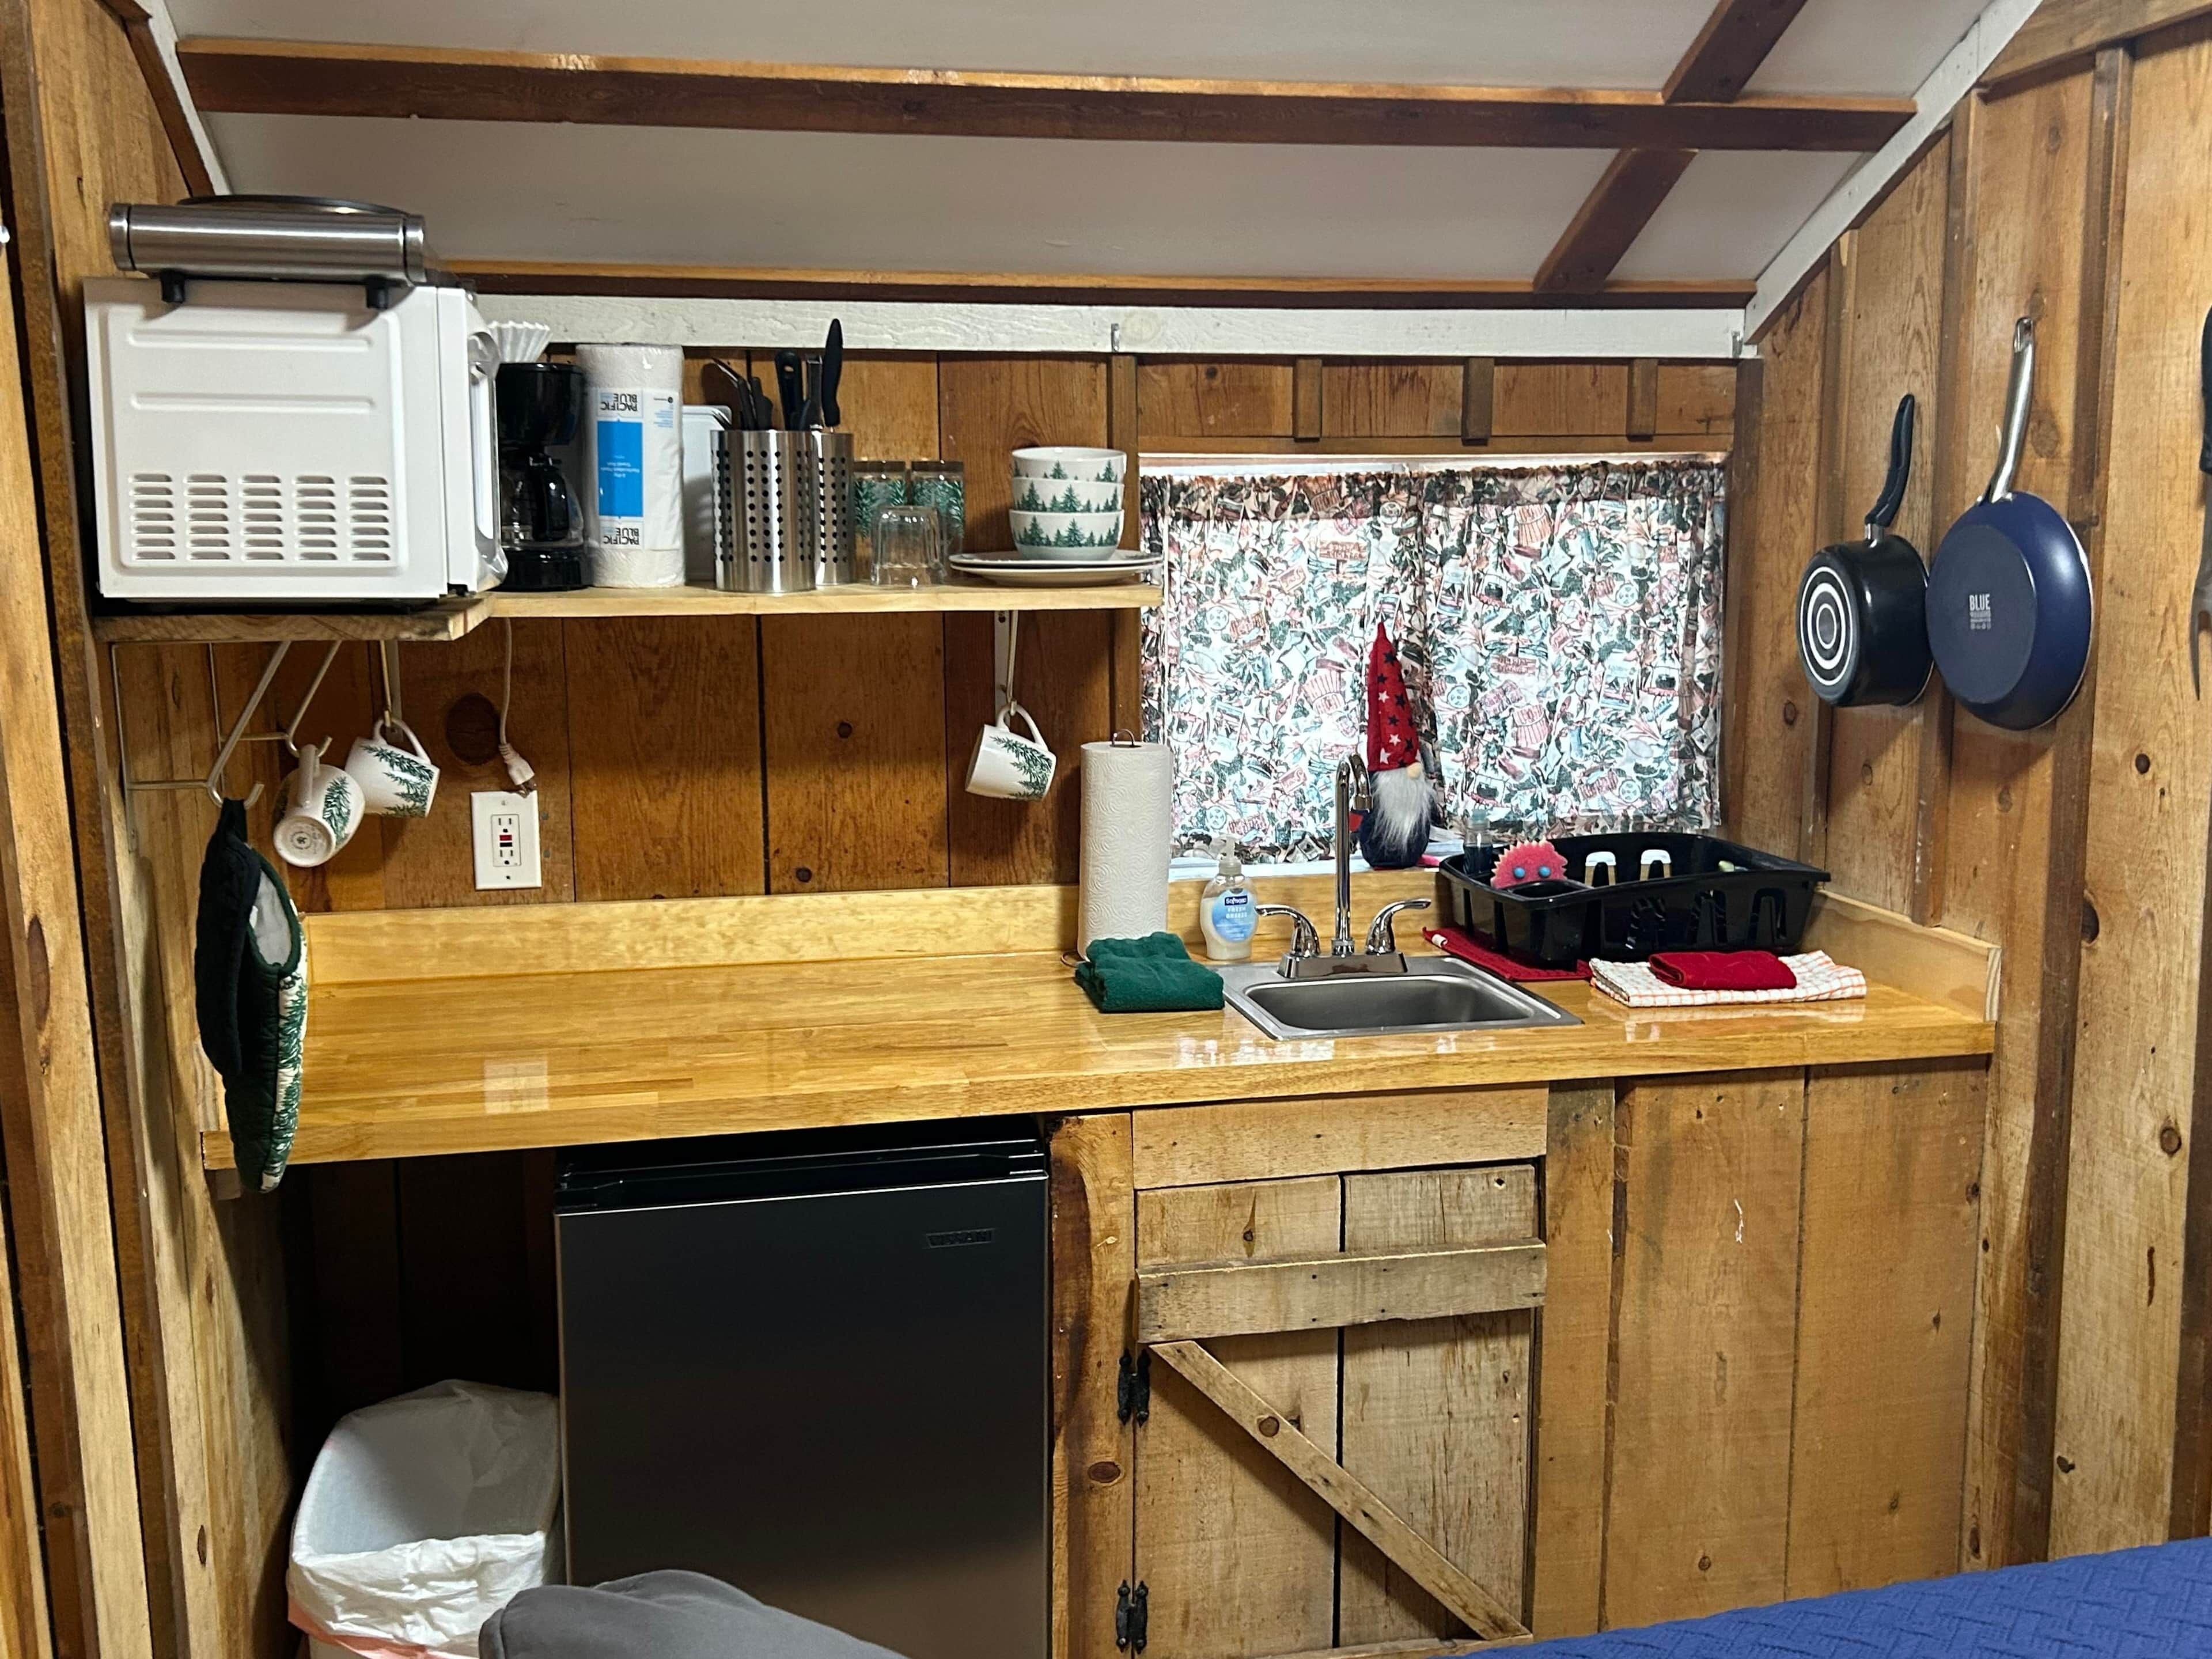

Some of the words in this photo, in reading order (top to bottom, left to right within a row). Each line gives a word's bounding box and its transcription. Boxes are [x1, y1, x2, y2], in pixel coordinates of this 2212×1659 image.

[613, 393, 637, 403] BLUE
[600, 402, 638, 411] PACIFIC
[616, 527, 639, 537] BLUE
[603, 536, 639, 545] PACIFIC
[1969, 593, 1991, 611] BLUE
